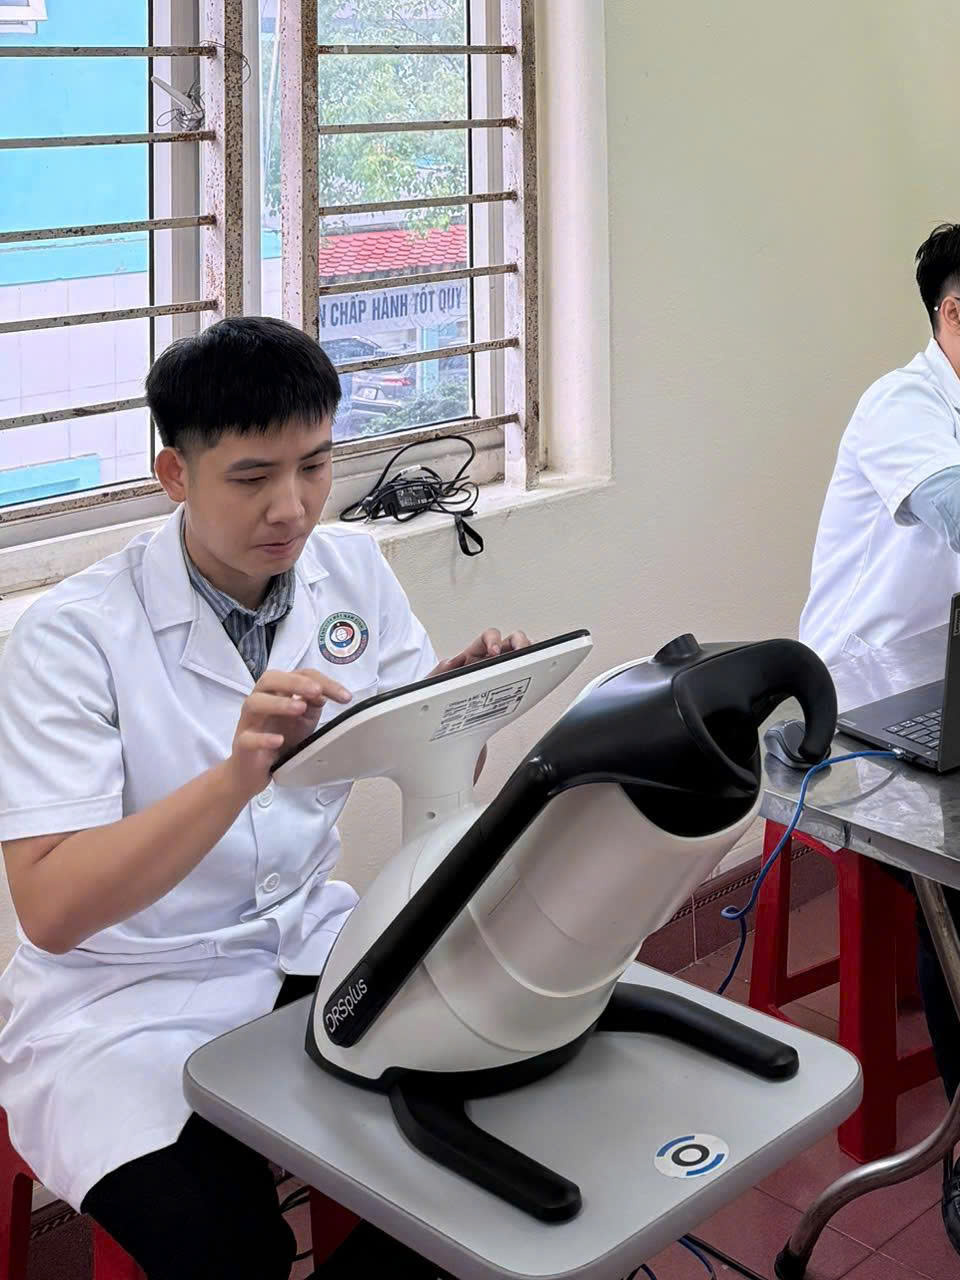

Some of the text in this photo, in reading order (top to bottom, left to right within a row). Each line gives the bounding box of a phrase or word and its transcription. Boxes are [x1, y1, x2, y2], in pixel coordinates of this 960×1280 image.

[330, 294, 367, 327] CHẤP
[372, 292, 408, 321] HÀNH
[413, 285, 435, 315] TỐT
